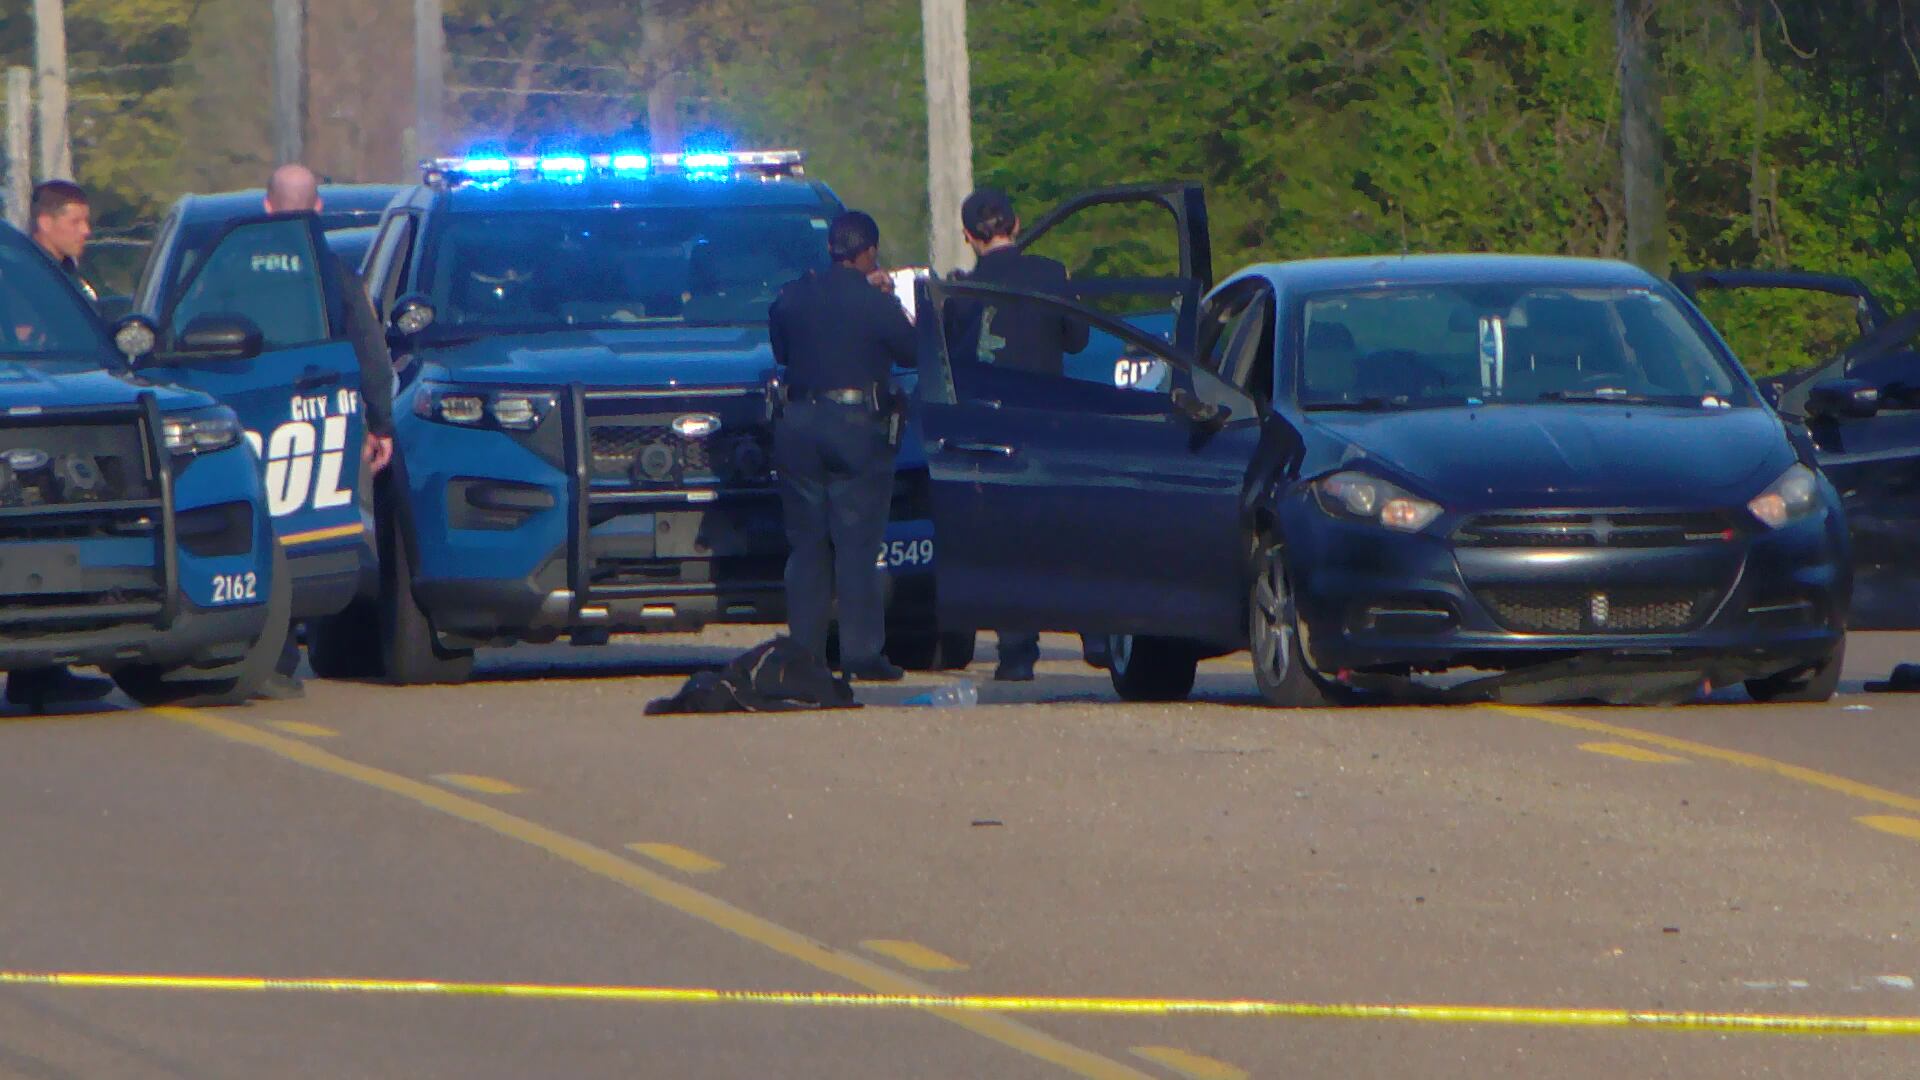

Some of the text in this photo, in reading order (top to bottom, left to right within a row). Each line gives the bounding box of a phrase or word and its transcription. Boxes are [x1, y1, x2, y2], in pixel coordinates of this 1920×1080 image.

[1114, 359, 1156, 386] CIT
[291, 388, 358, 421] CITY OF
[876, 539, 934, 568] 2549
[212, 571, 257, 602] 2162
